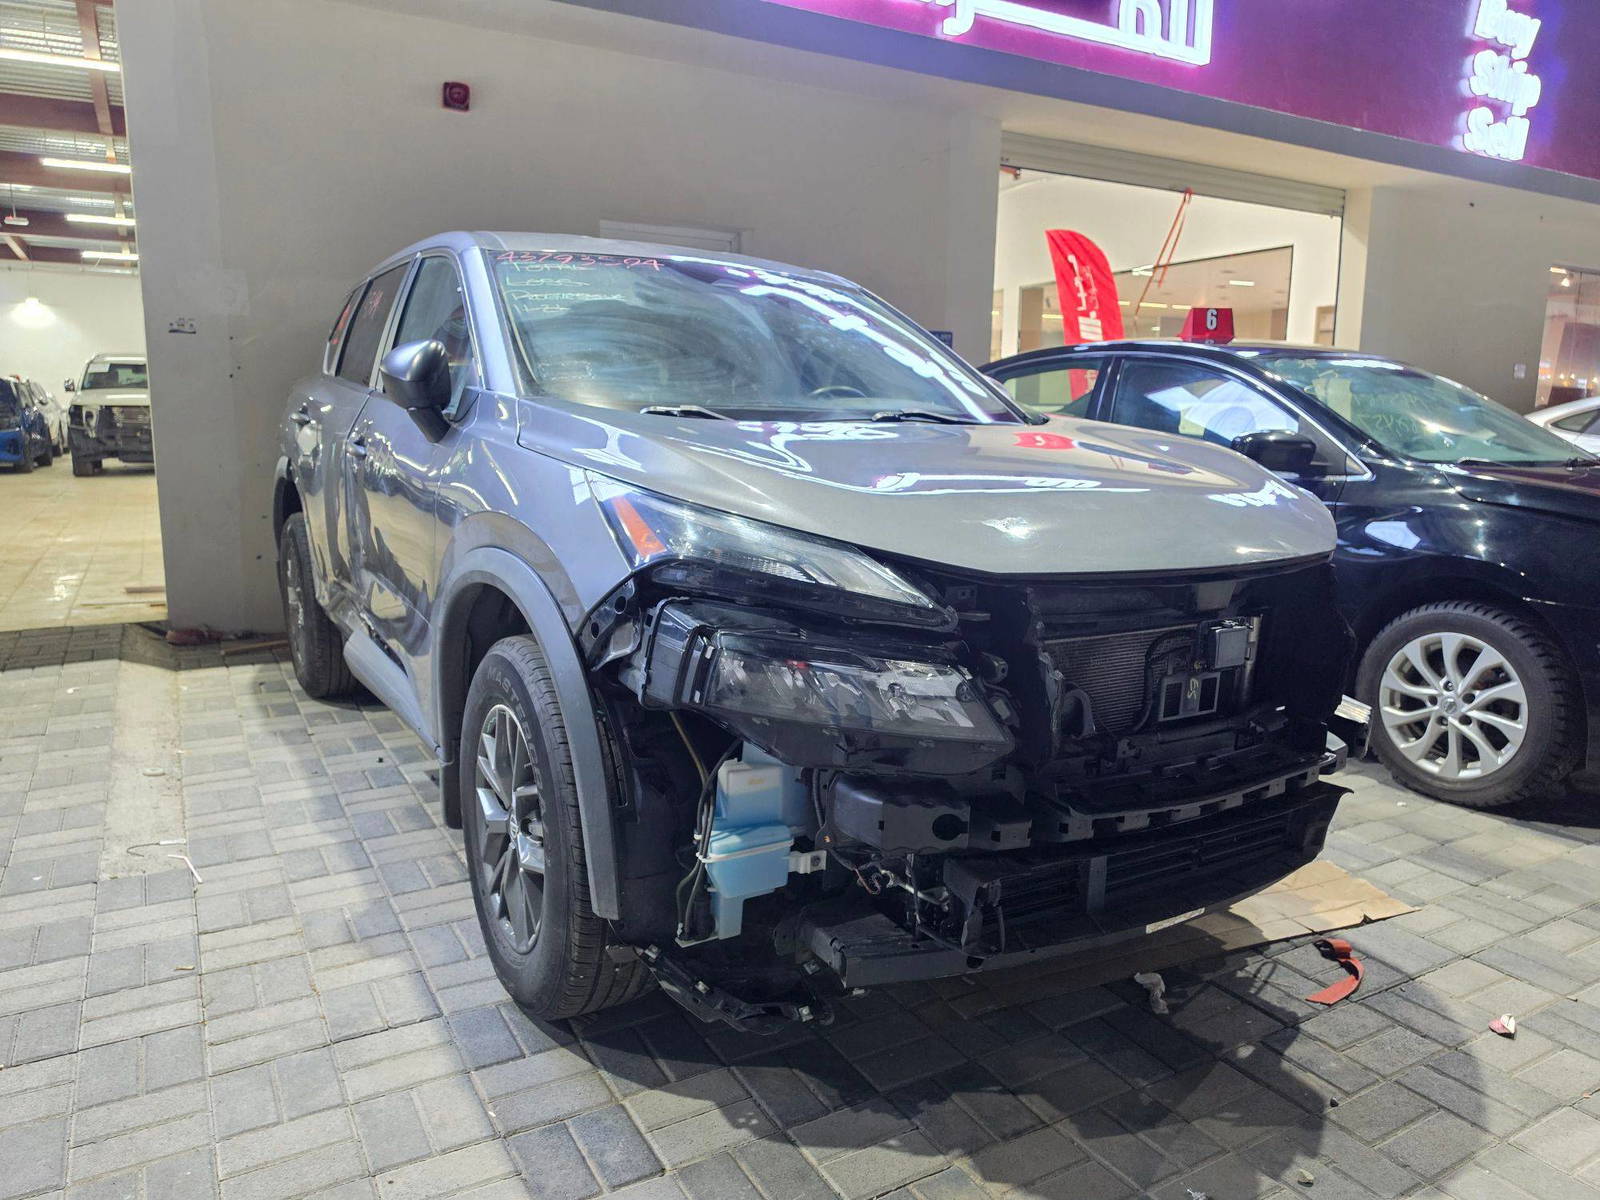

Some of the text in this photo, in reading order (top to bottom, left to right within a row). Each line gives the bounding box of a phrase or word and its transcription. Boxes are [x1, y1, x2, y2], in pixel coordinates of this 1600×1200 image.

[1474, 0, 1541, 59] Buy
[1469, 50, 1541, 116] Ship
[1463, 107, 1530, 160] Sell
[1206, 308, 1218, 330] 6
